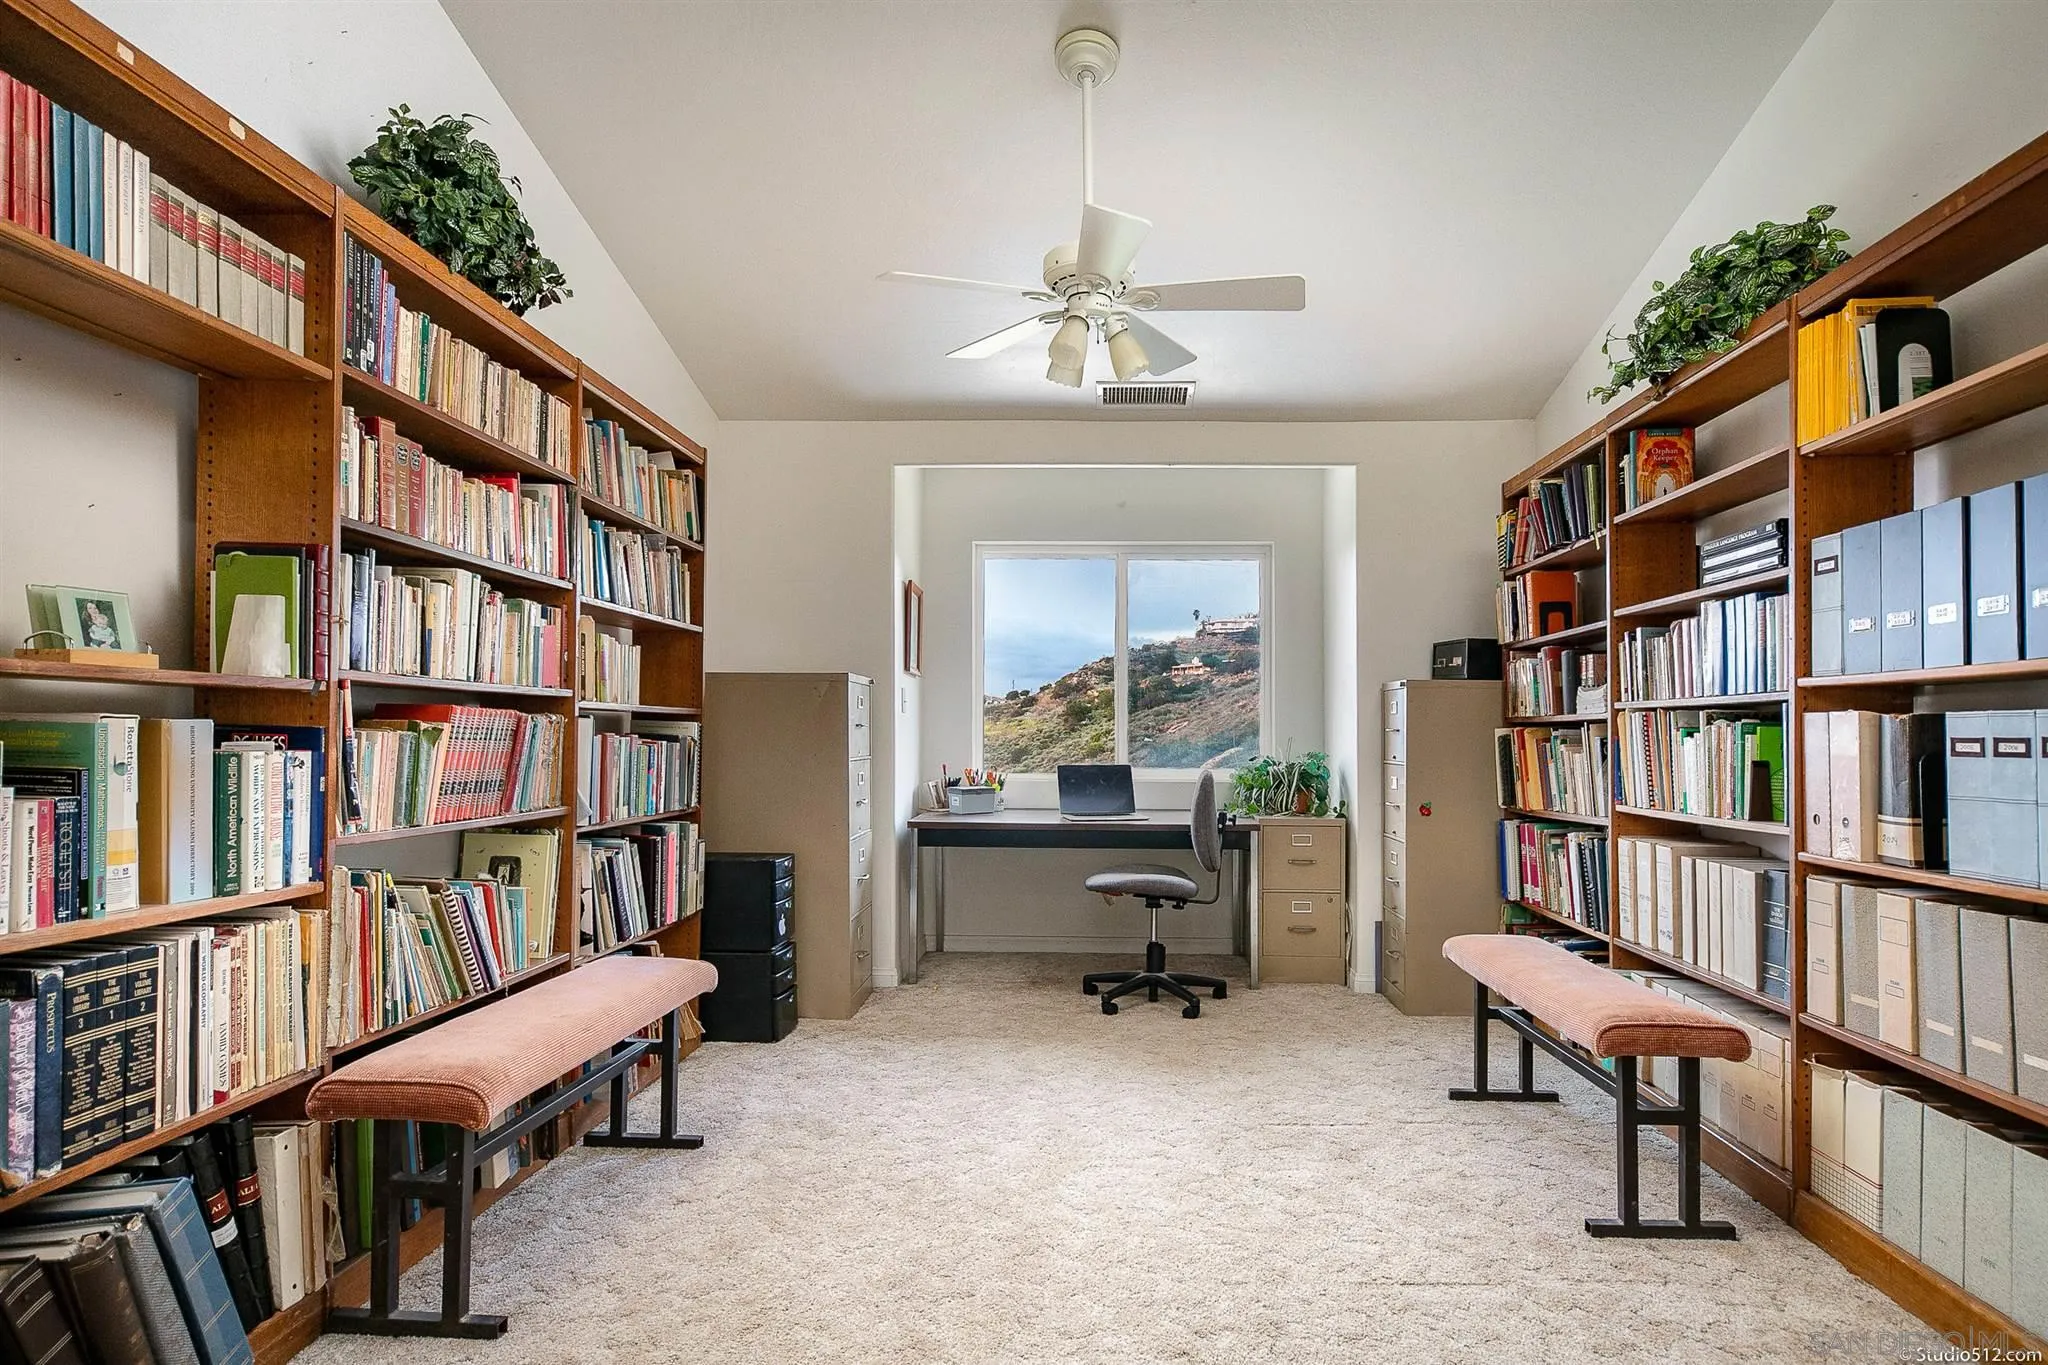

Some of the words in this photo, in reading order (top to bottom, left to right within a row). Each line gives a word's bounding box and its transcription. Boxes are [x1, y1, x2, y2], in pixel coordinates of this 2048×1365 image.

[1651, 448, 1678, 456] Orphan
[98, 728, 107, 780] Understanding
[228, 756, 238, 793] Wildlife
[270, 762, 282, 814] CONFRONTING
[228, 796, 238, 846] American
[270, 817, 282, 840] ABUSE
[2, 822, 11, 850] Shoots
[59, 822, 72, 879] ROGET'S
[228, 850, 238, 878] North
[0, 864, 10, 894] Leaves
[108, 978, 117, 987] THE
[135, 978, 152, 988] VOLUME
[140, 970, 148, 979] THE
[73, 993, 90, 1004] VOLUME
[104, 986, 120, 996] VOLUME
[134, 986, 152, 997] LIBRARY
[72, 1002, 90, 1012] LIBRARY
[103, 994, 121, 1006] LIBRARY
[140, 1001, 146, 1012] 2
[46, 992, 56, 1053] PROSPECTUS
[79, 1018, 84, 1028] 3
[110, 1010, 114, 1020] 1
[219, 1022, 227, 1053] FAMILY
[219, 1055, 227, 1086] GAMES
